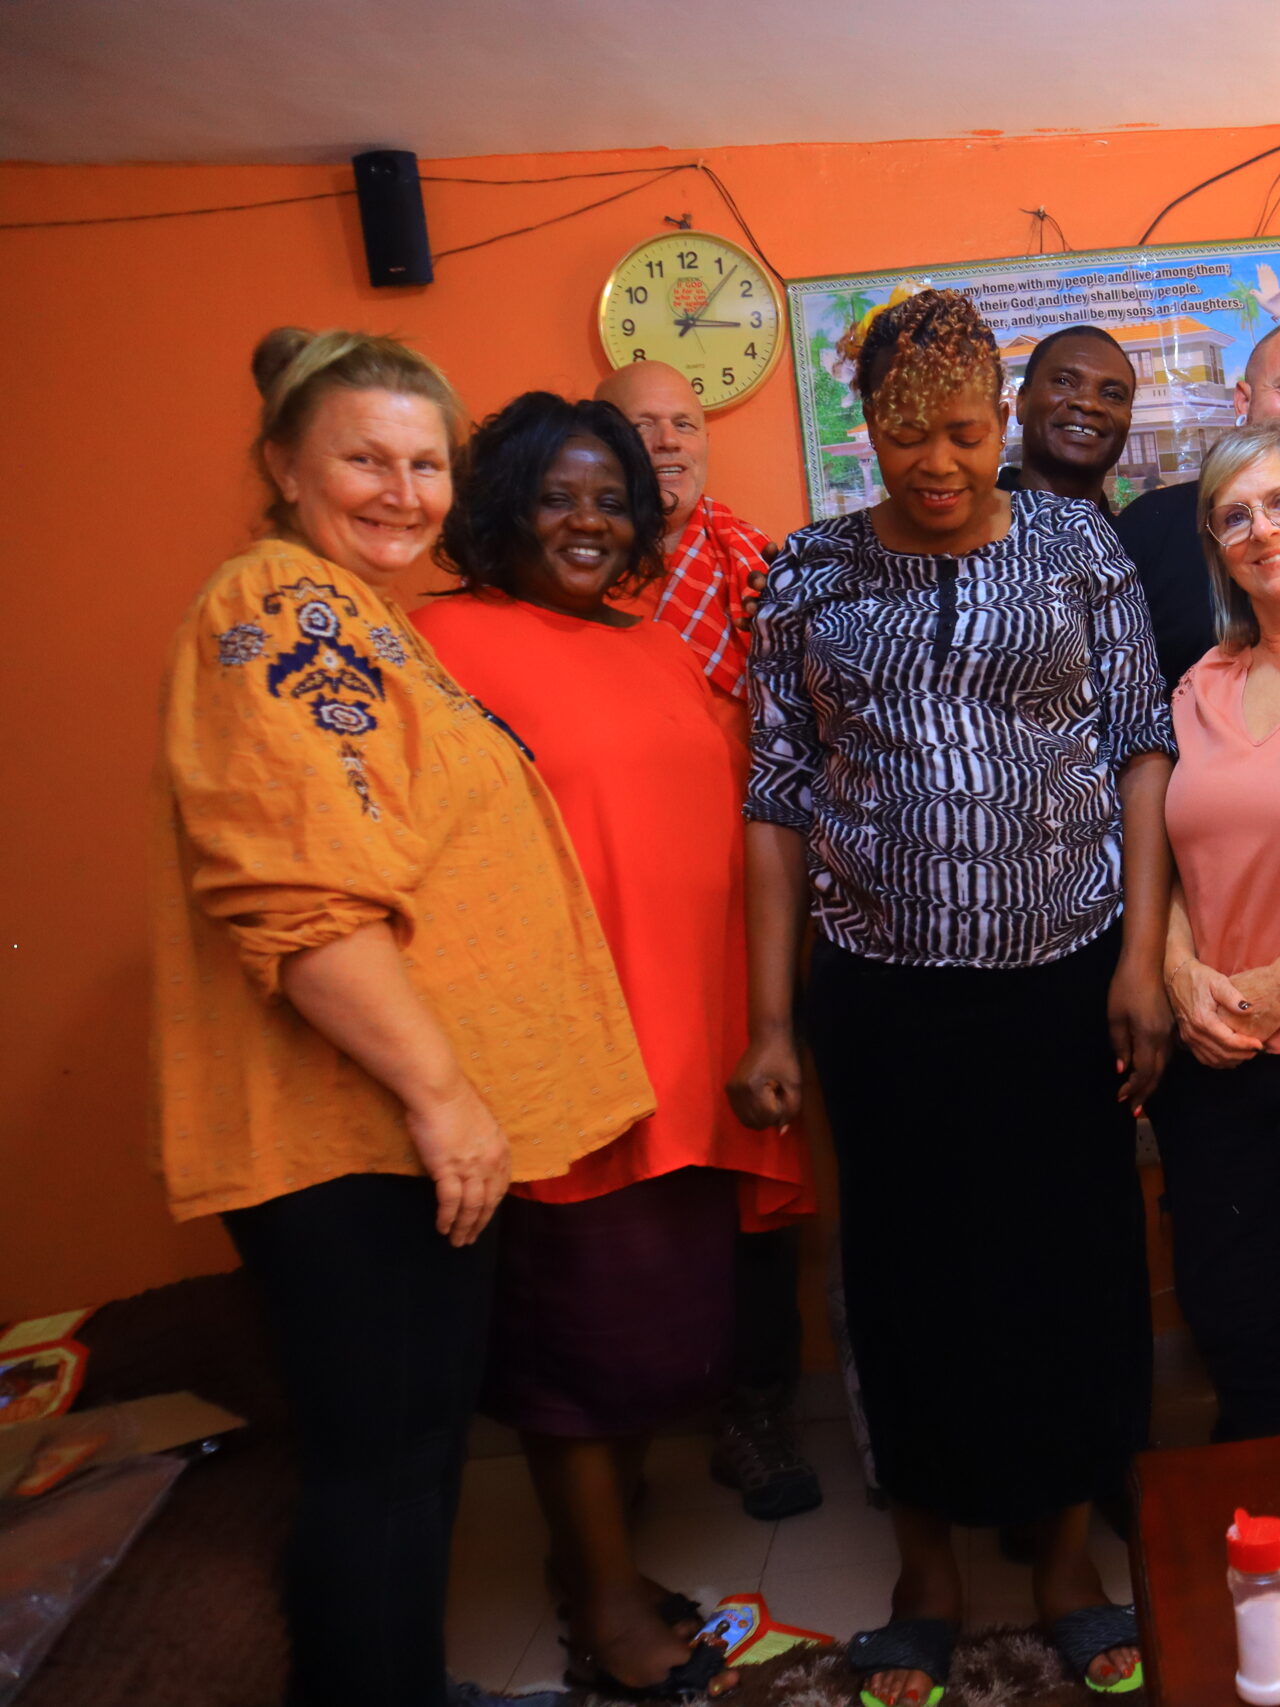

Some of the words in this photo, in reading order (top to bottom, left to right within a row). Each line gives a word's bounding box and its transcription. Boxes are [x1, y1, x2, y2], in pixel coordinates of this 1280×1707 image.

[645, 260, 664, 278] 11
[677, 251, 699, 270] 12
[714, 257, 724, 275] 1
[740, 280, 753, 298] 2
[963, 287, 980, 299] my
[983, 283, 1015, 294] home
[1018, 278, 1043, 290] with
[1046, 278, 1063, 290] my
[1065, 273, 1105, 288] people
[1108, 271, 1129, 282] and
[1131, 270, 1151, 281] live
[1155, 267, 1195, 280] among
[1196, 264, 1231, 275] them;
[626, 286, 648, 305] 10
[980, 300, 1008, 311] their
[1063, 292, 1088, 305] they
[1091, 289, 1119, 301] shall
[1121, 288, 1136, 299] be
[1139, 289, 1155, 301] my
[1157, 283, 1201, 299] people.
[750, 311, 762, 329] 3
[1011, 315, 1033, 326] and
[1035, 315, 1057, 328] you
[1059, 310, 1087, 321] shall
[1090, 308, 1105, 319] be
[1107, 308, 1125, 321] my
[1126, 306, 1153, 317] sons
[1157, 303, 1177, 315] and
[1180, 298, 1243, 314] daughters.
[622, 319, 636, 337] 9
[744, 342, 757, 360] 4
[722, 367, 735, 386] 5
[691, 377, 705, 396] 6
